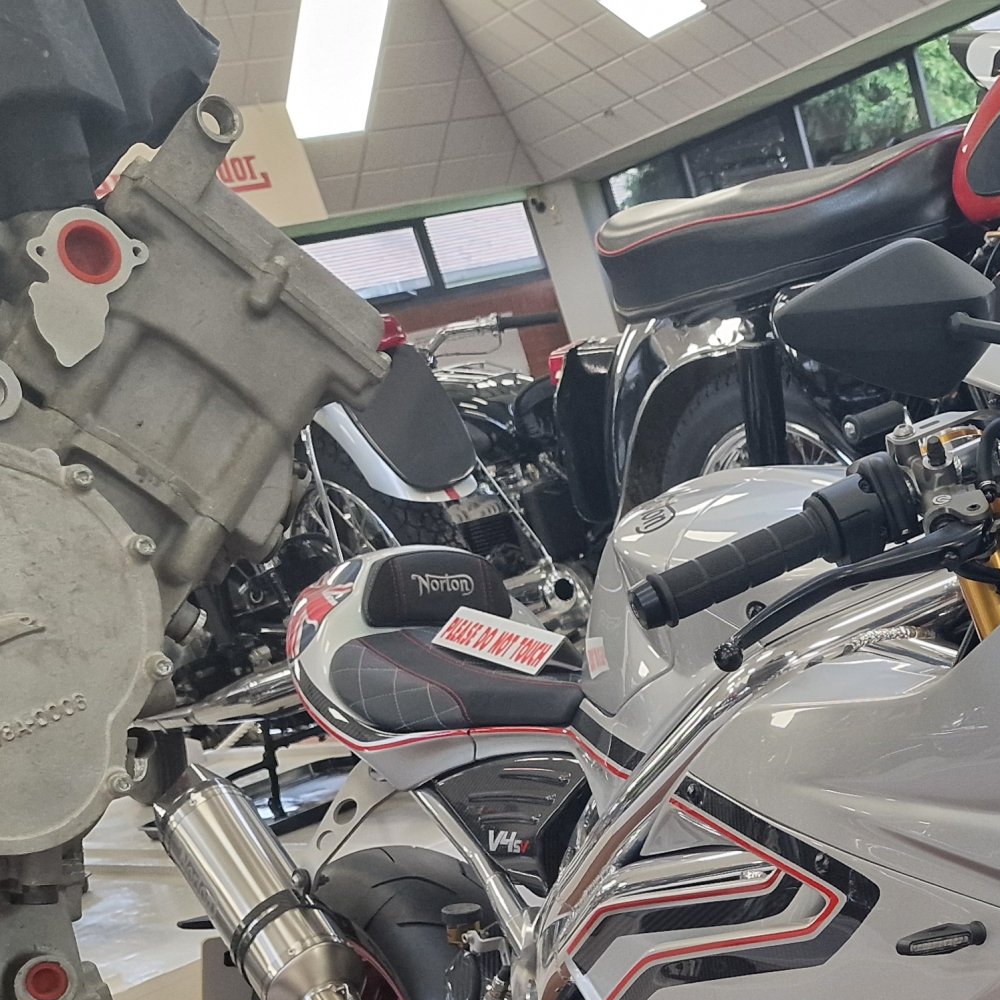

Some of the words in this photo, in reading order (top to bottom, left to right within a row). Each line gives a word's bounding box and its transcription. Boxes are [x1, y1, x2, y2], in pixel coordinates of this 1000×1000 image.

[411, 574, 474, 596] Norton
[441, 617, 484, 646] PLEASE
[473, 626, 498, 651] DO
[489, 631, 517, 657] NOT
[510, 636, 552, 668] TOUCH
